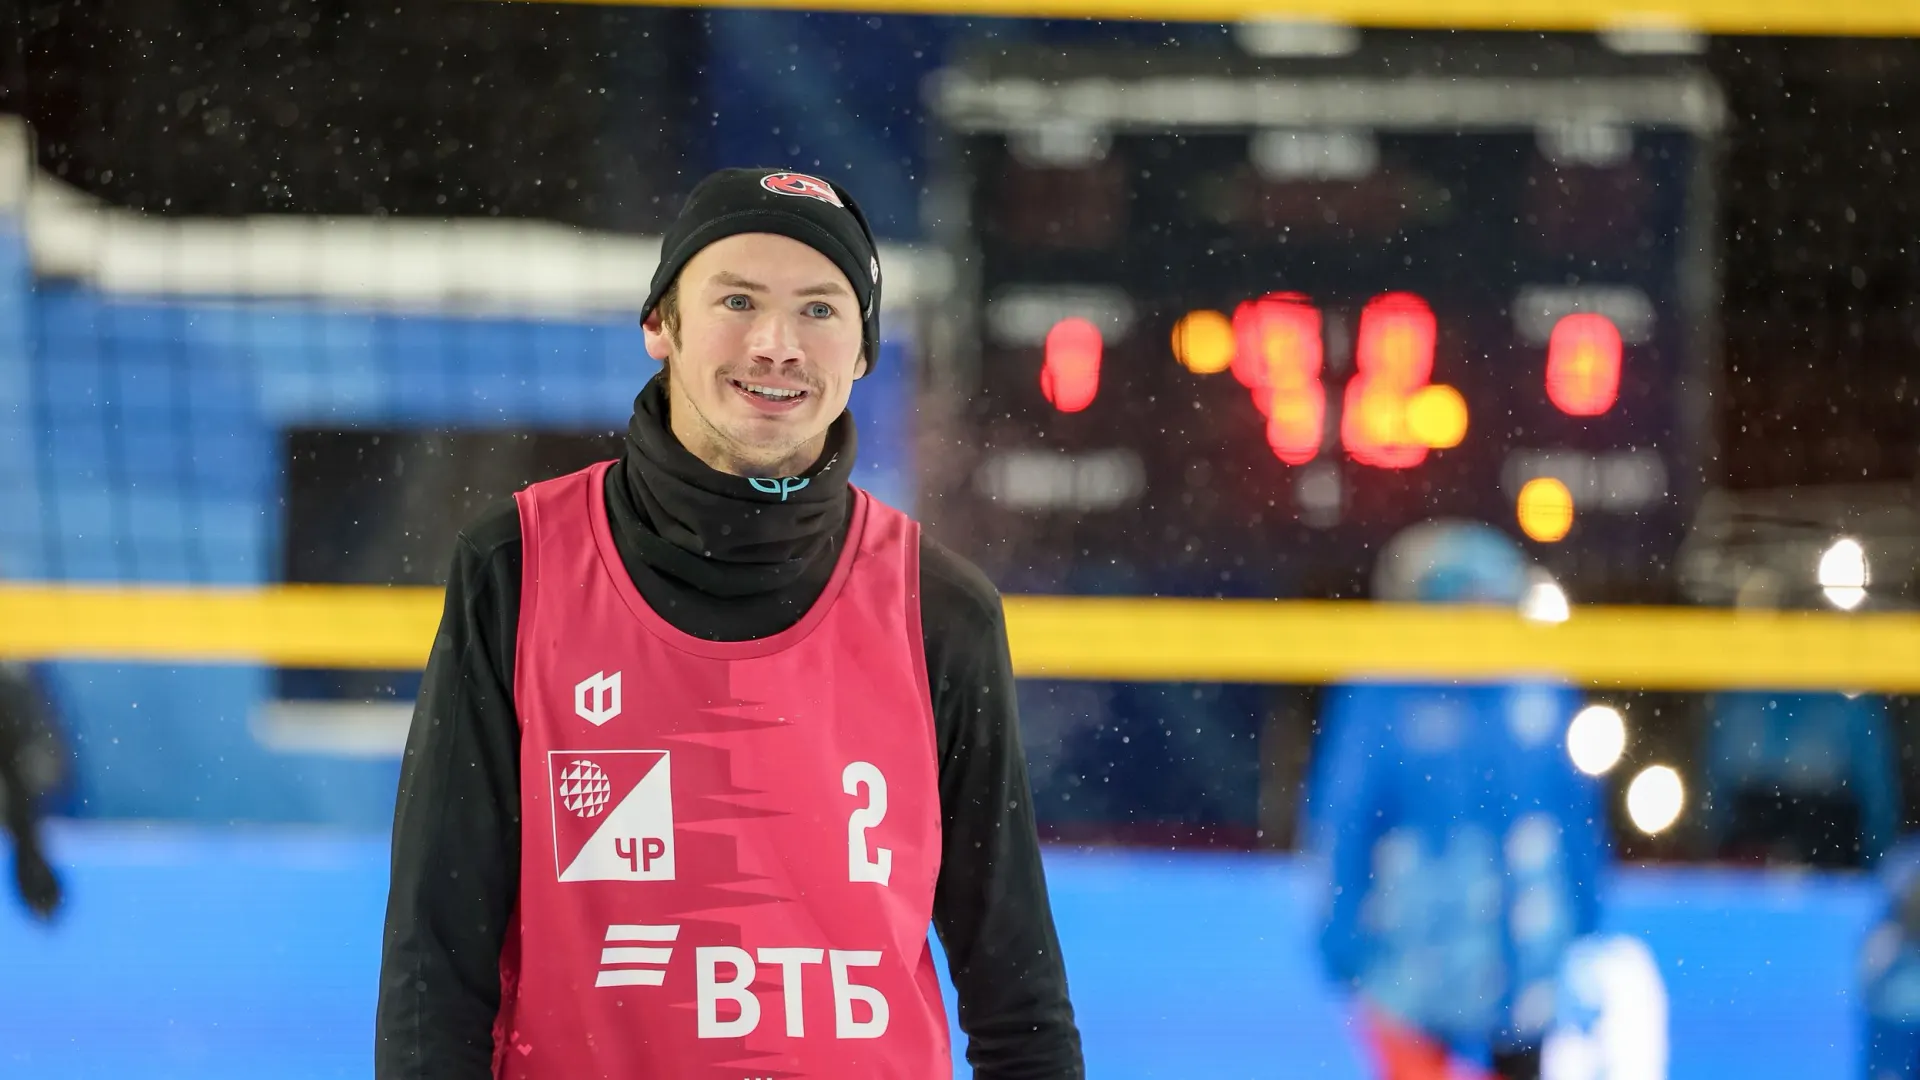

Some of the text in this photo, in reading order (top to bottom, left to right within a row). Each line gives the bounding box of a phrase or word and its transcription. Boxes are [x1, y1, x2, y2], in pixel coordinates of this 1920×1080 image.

[614, 837, 666, 873] ЧР
[841, 761, 893, 888] 2
[695, 945, 890, 1039] ВТБ
